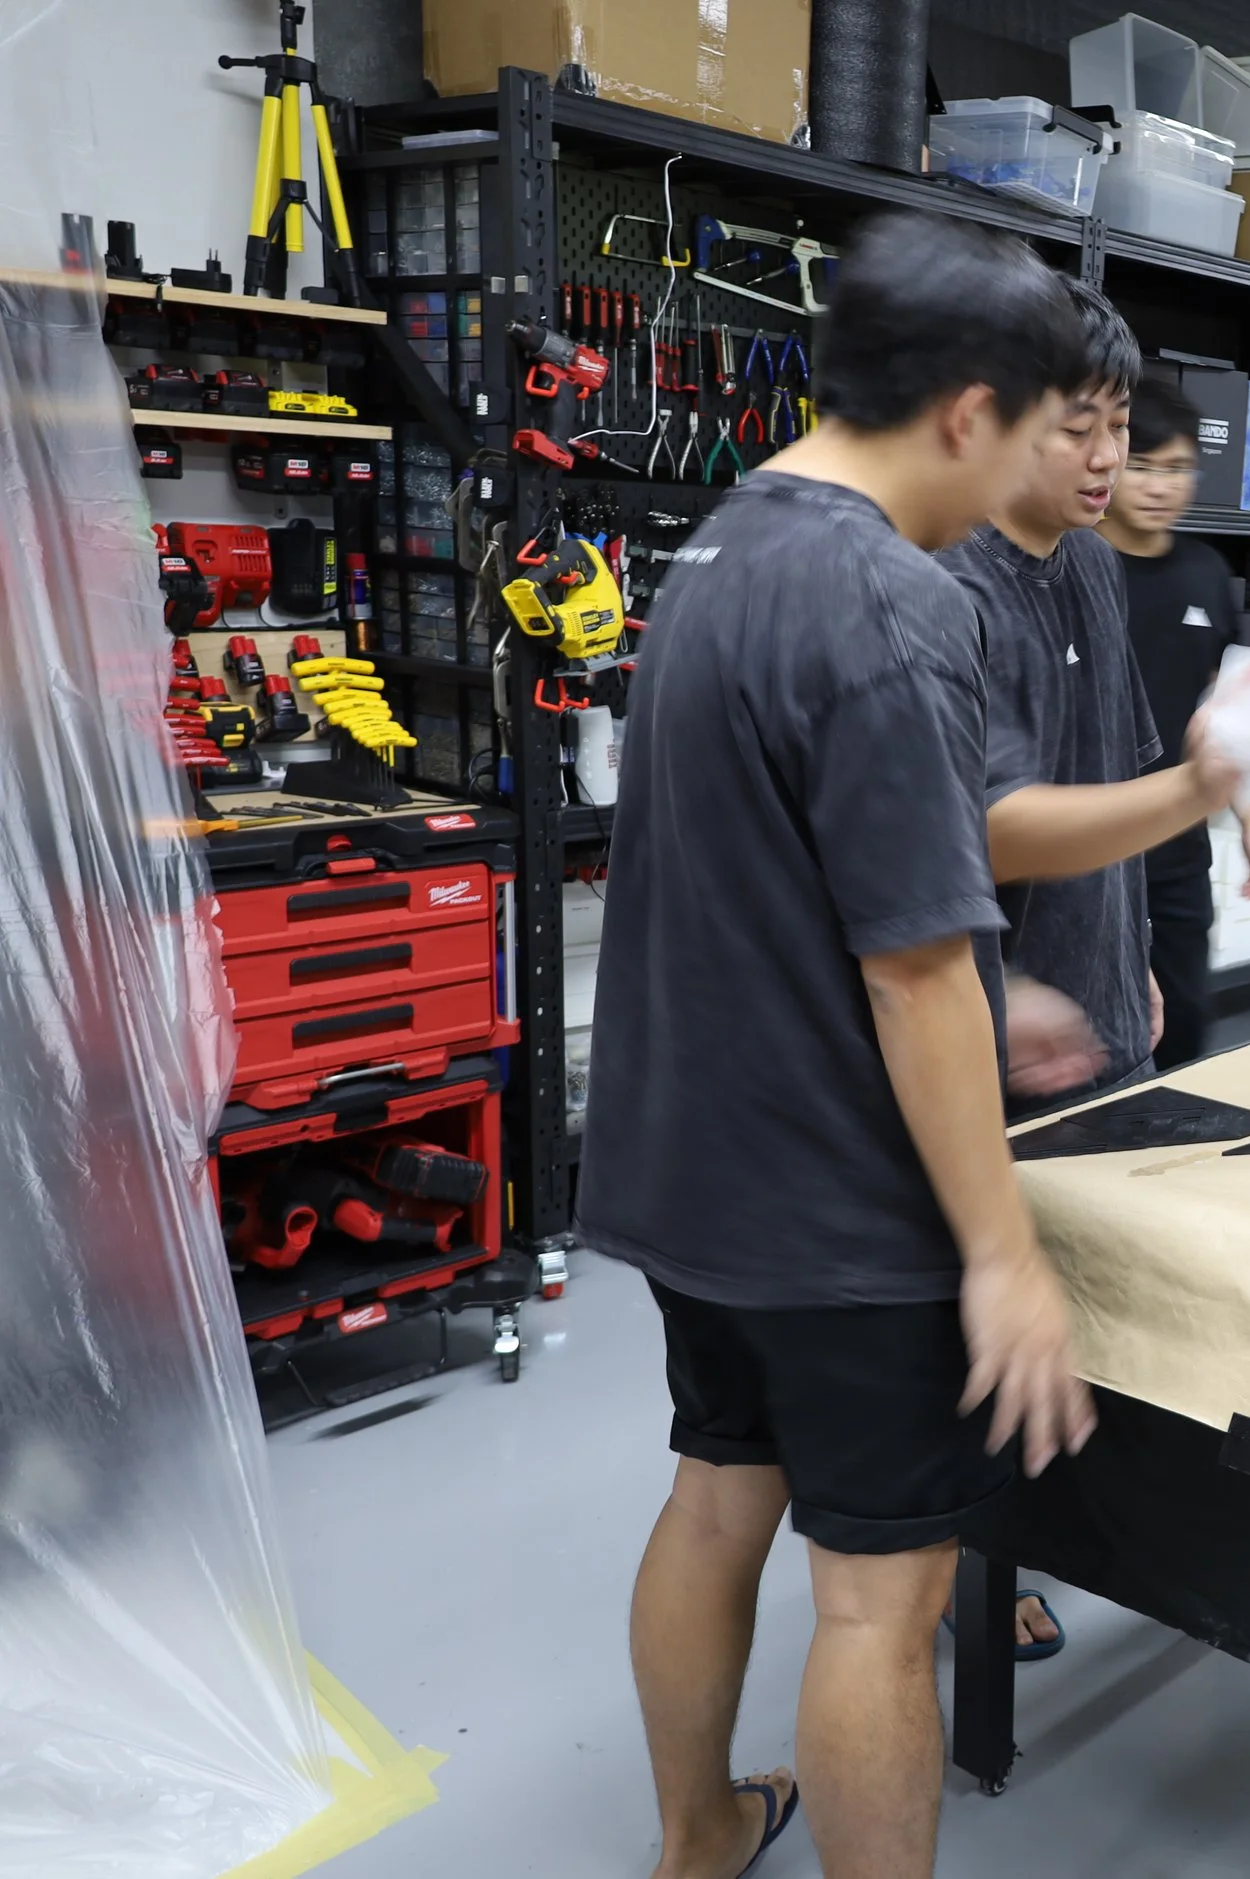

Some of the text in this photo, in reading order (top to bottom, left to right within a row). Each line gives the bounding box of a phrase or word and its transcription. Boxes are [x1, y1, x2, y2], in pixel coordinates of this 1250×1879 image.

[1198, 424, 1229, 438] BANDO
[428, 881, 471, 901] Milwaukee
[449, 895, 482, 904] PACKOUT
